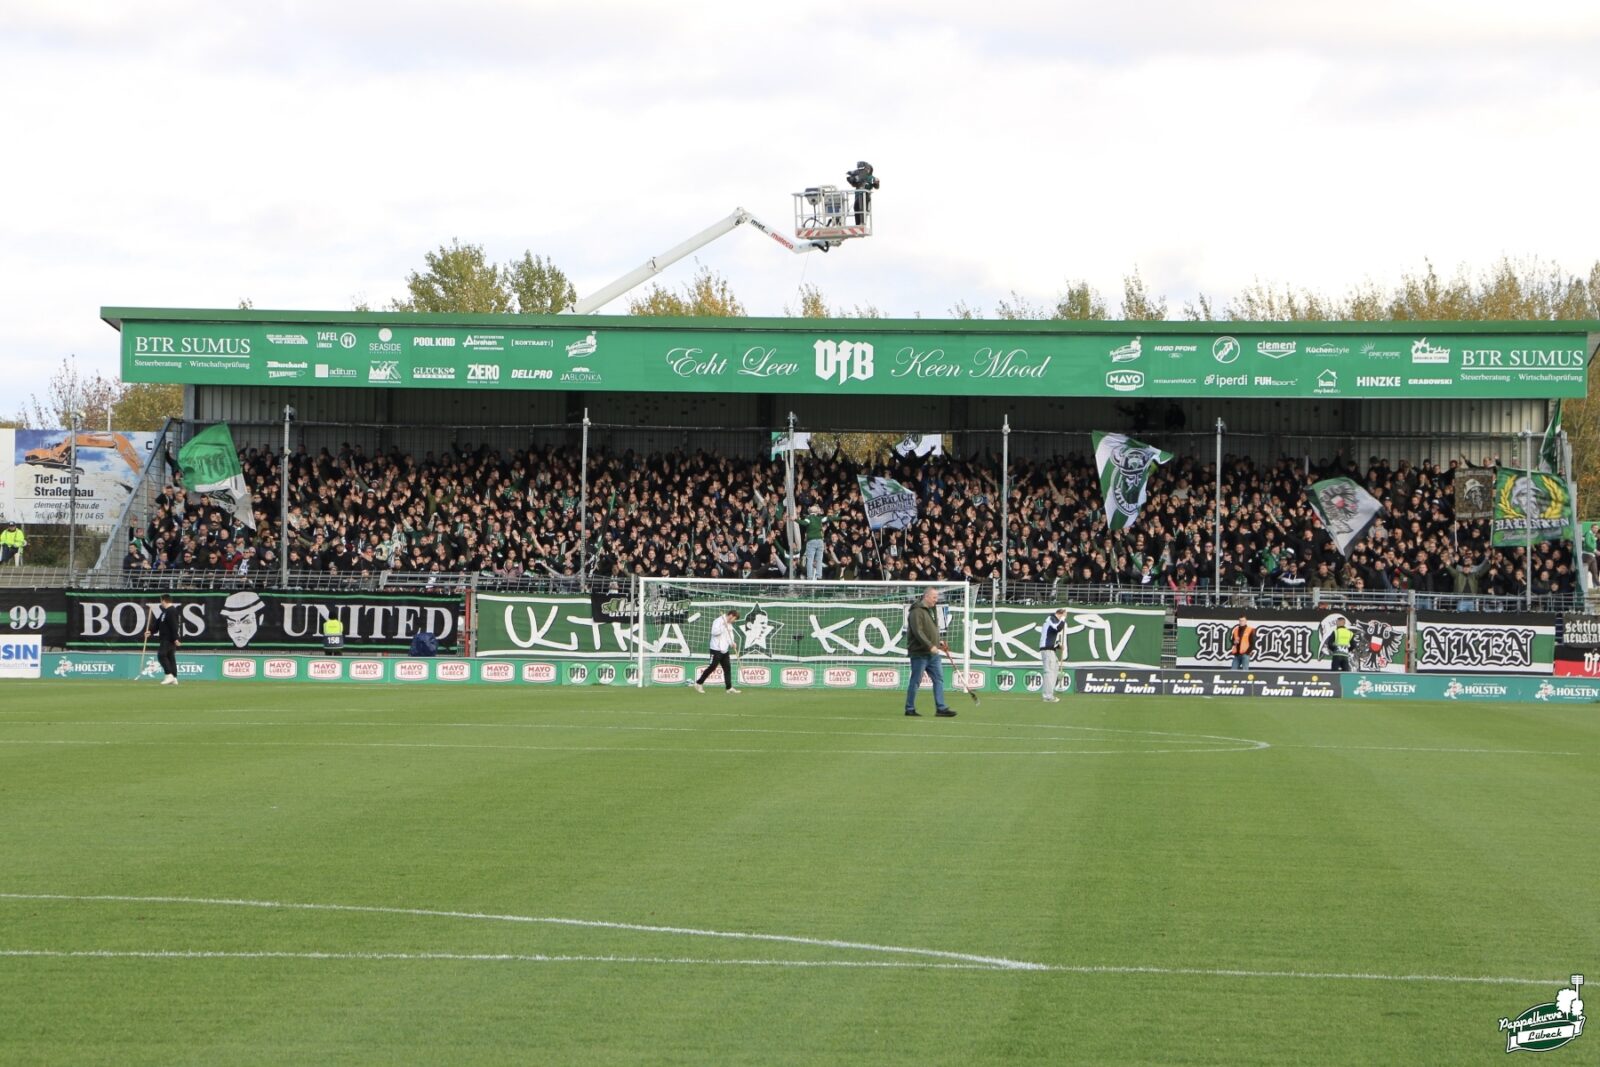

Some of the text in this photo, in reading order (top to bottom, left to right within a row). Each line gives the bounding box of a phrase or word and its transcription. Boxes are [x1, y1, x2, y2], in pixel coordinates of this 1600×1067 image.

[771, 232, 794, 250] mateco
[317, 332, 338, 341] TAFEL
[136, 336, 175, 352] BTR
[181, 338, 250, 354] SUMUS
[369, 343, 402, 352] SEASIDE
[1257, 341, 1296, 350] clement
[1306, 346, 1350, 355] Küchenstyle
[666, 346, 799, 378] Echt Leev
[813, 339, 874, 386] VfB
[891, 346, 1052, 378] Keen Mood
[1462, 350, 1584, 367] BTR SUMUS
[134, 360, 250, 370] Steuerberatung Wirtschaftsprüfung
[511, 369, 554, 379] DELLPRO
[1110, 375, 1140, 383] MAYO
[1460, 374, 1582, 382] Steuerberatung Wirtschaftsprüfung
[1216, 374, 1248, 387] iperdi
[1356, 376, 1400, 386] HINZKE
[34, 474, 58, 484] Tief-
[9, 606, 46, 630] 99
[280, 602, 453, 640] UNITED
[74, 664, 115, 673] HOLSTEN
[570, 668, 585, 679] VfB
[598, 668, 614, 679] VfB
[997, 674, 1014, 685] VfB
[1026, 675, 1041, 686] VfB
[1084, 682, 1115, 693] bwin
[1124, 684, 1155, 693] bwin
[1173, 684, 1204, 694] bwin
[1213, 685, 1244, 694] bwin
[1262, 686, 1293, 696] bwin
[1302, 687, 1334, 697] bwin
[1374, 684, 1416, 693] HOLSTEN
[1465, 686, 1507, 695] HOLSTEN
[1556, 688, 1598, 696] HOLSTEN
